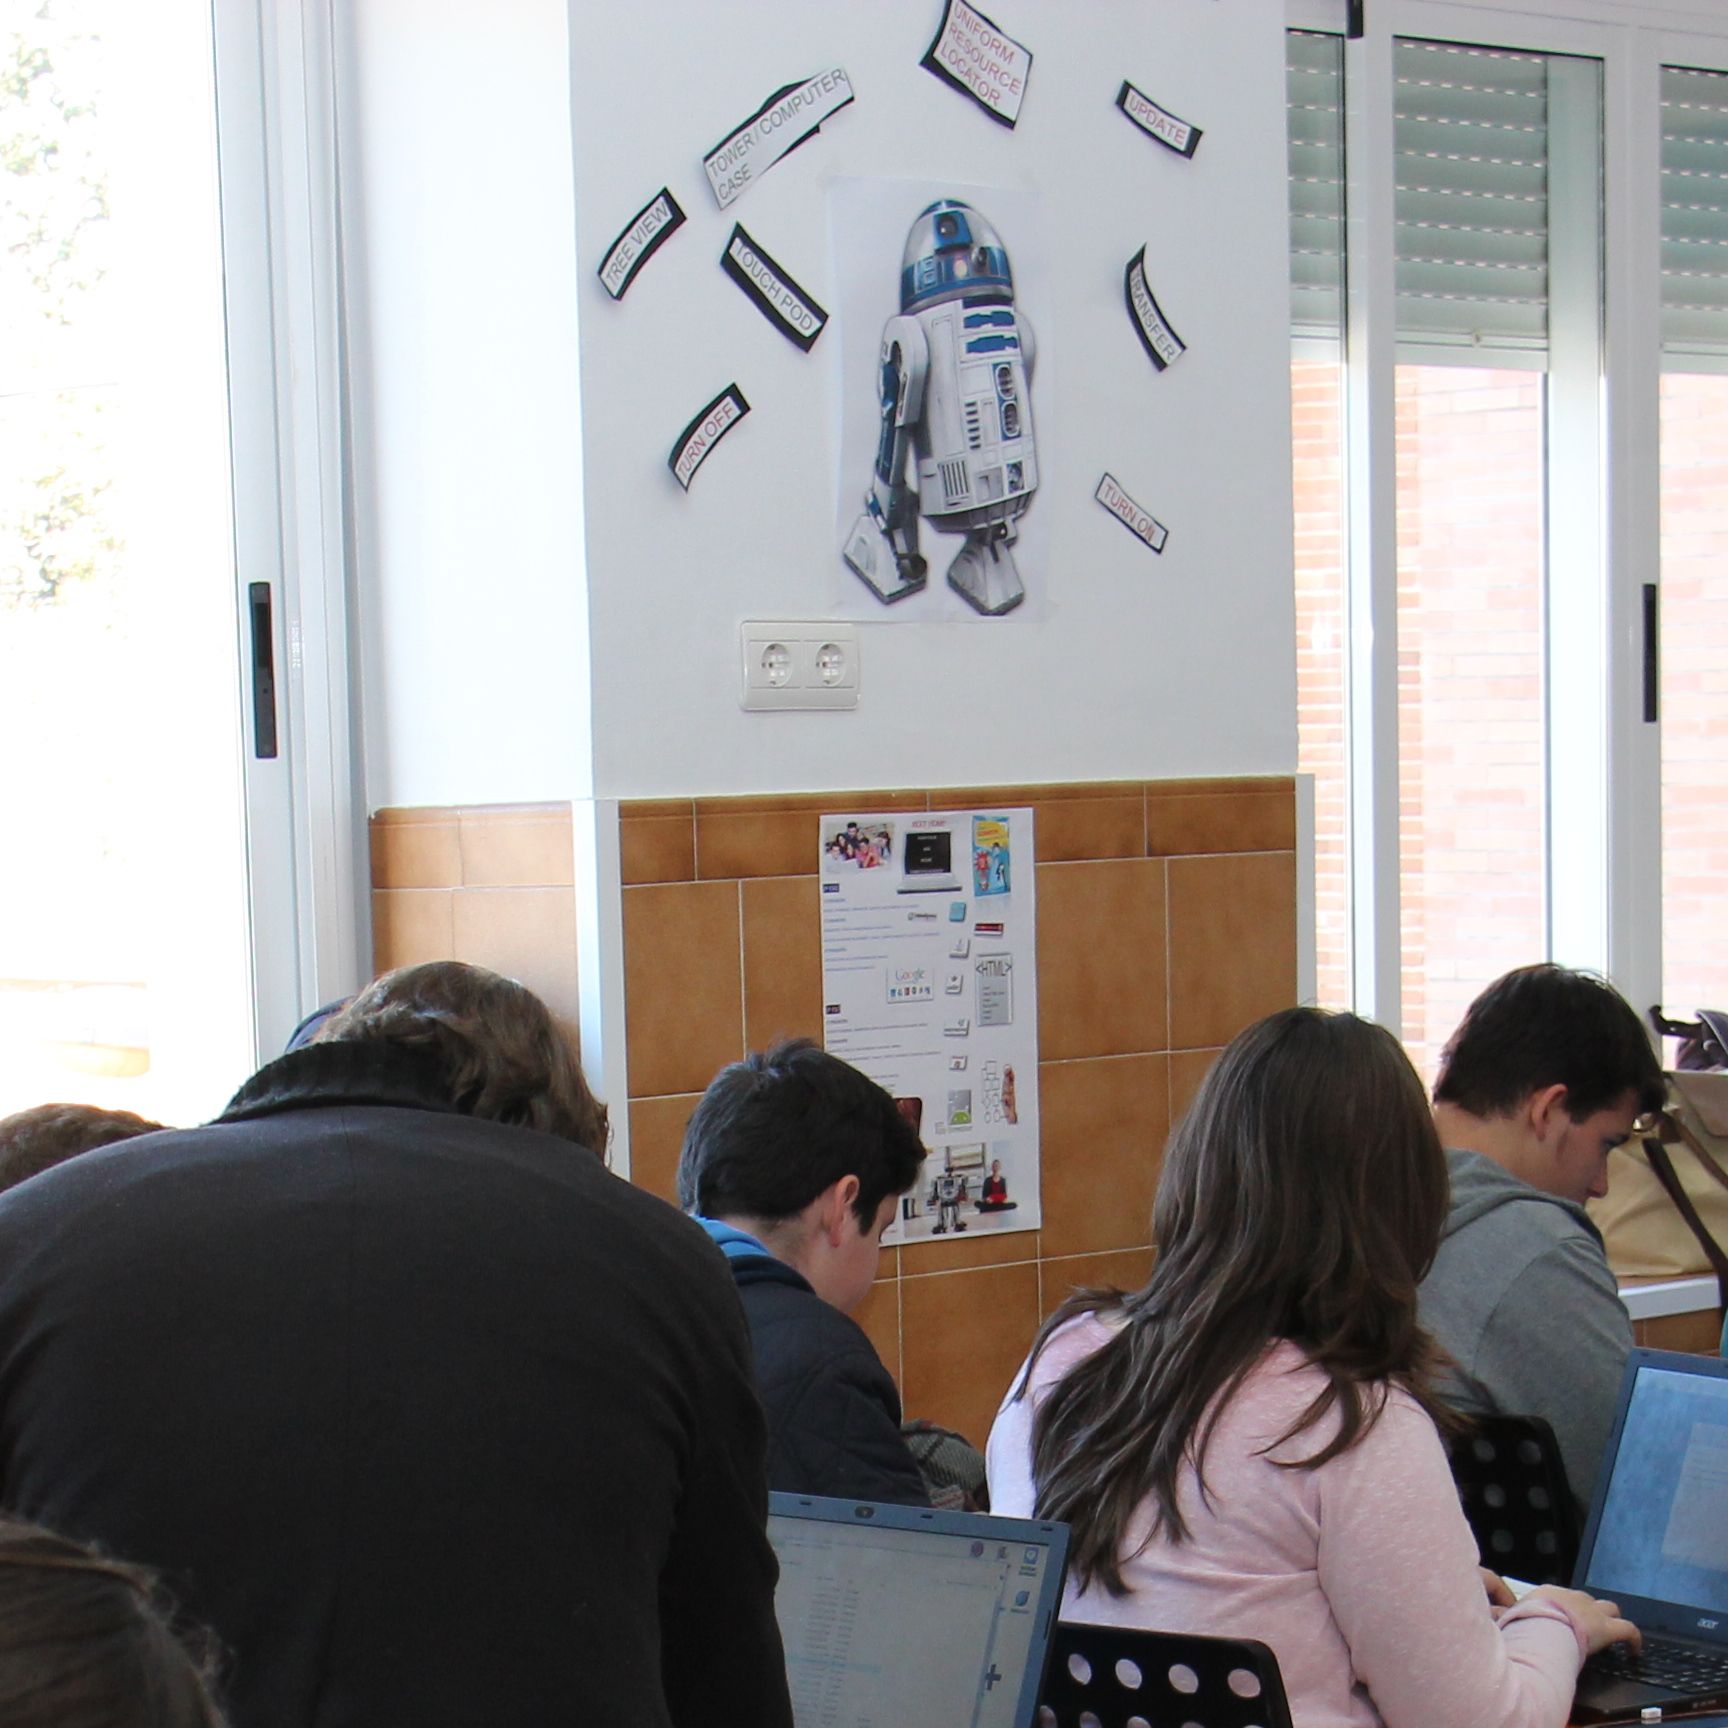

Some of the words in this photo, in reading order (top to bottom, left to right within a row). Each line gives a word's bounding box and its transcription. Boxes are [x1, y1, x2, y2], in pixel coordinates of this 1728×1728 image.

[949, 22, 1022, 95] RESOURCE
[954, 2, 1015, 64] UNIFORM
[759, 68, 847, 135] COMPUTER
[941, 42, 1001, 106] LOCATOR
[1129, 94, 1187, 145] UPDATE
[717, 163, 753, 200] CASE
[605, 245, 636, 287] TREE
[631, 200, 669, 244] VIEW
[734, 243, 780, 299] TOUCH
[780, 294, 813, 332] POD
[1130, 270, 1175, 361] TRANSFER
[677, 436, 707, 478] TURN
[704, 402, 734, 438] OFF
[1104, 484, 1136, 523] TURN
[1136, 516, 1156, 542] ON
[895, 967, 927, 983] Google
